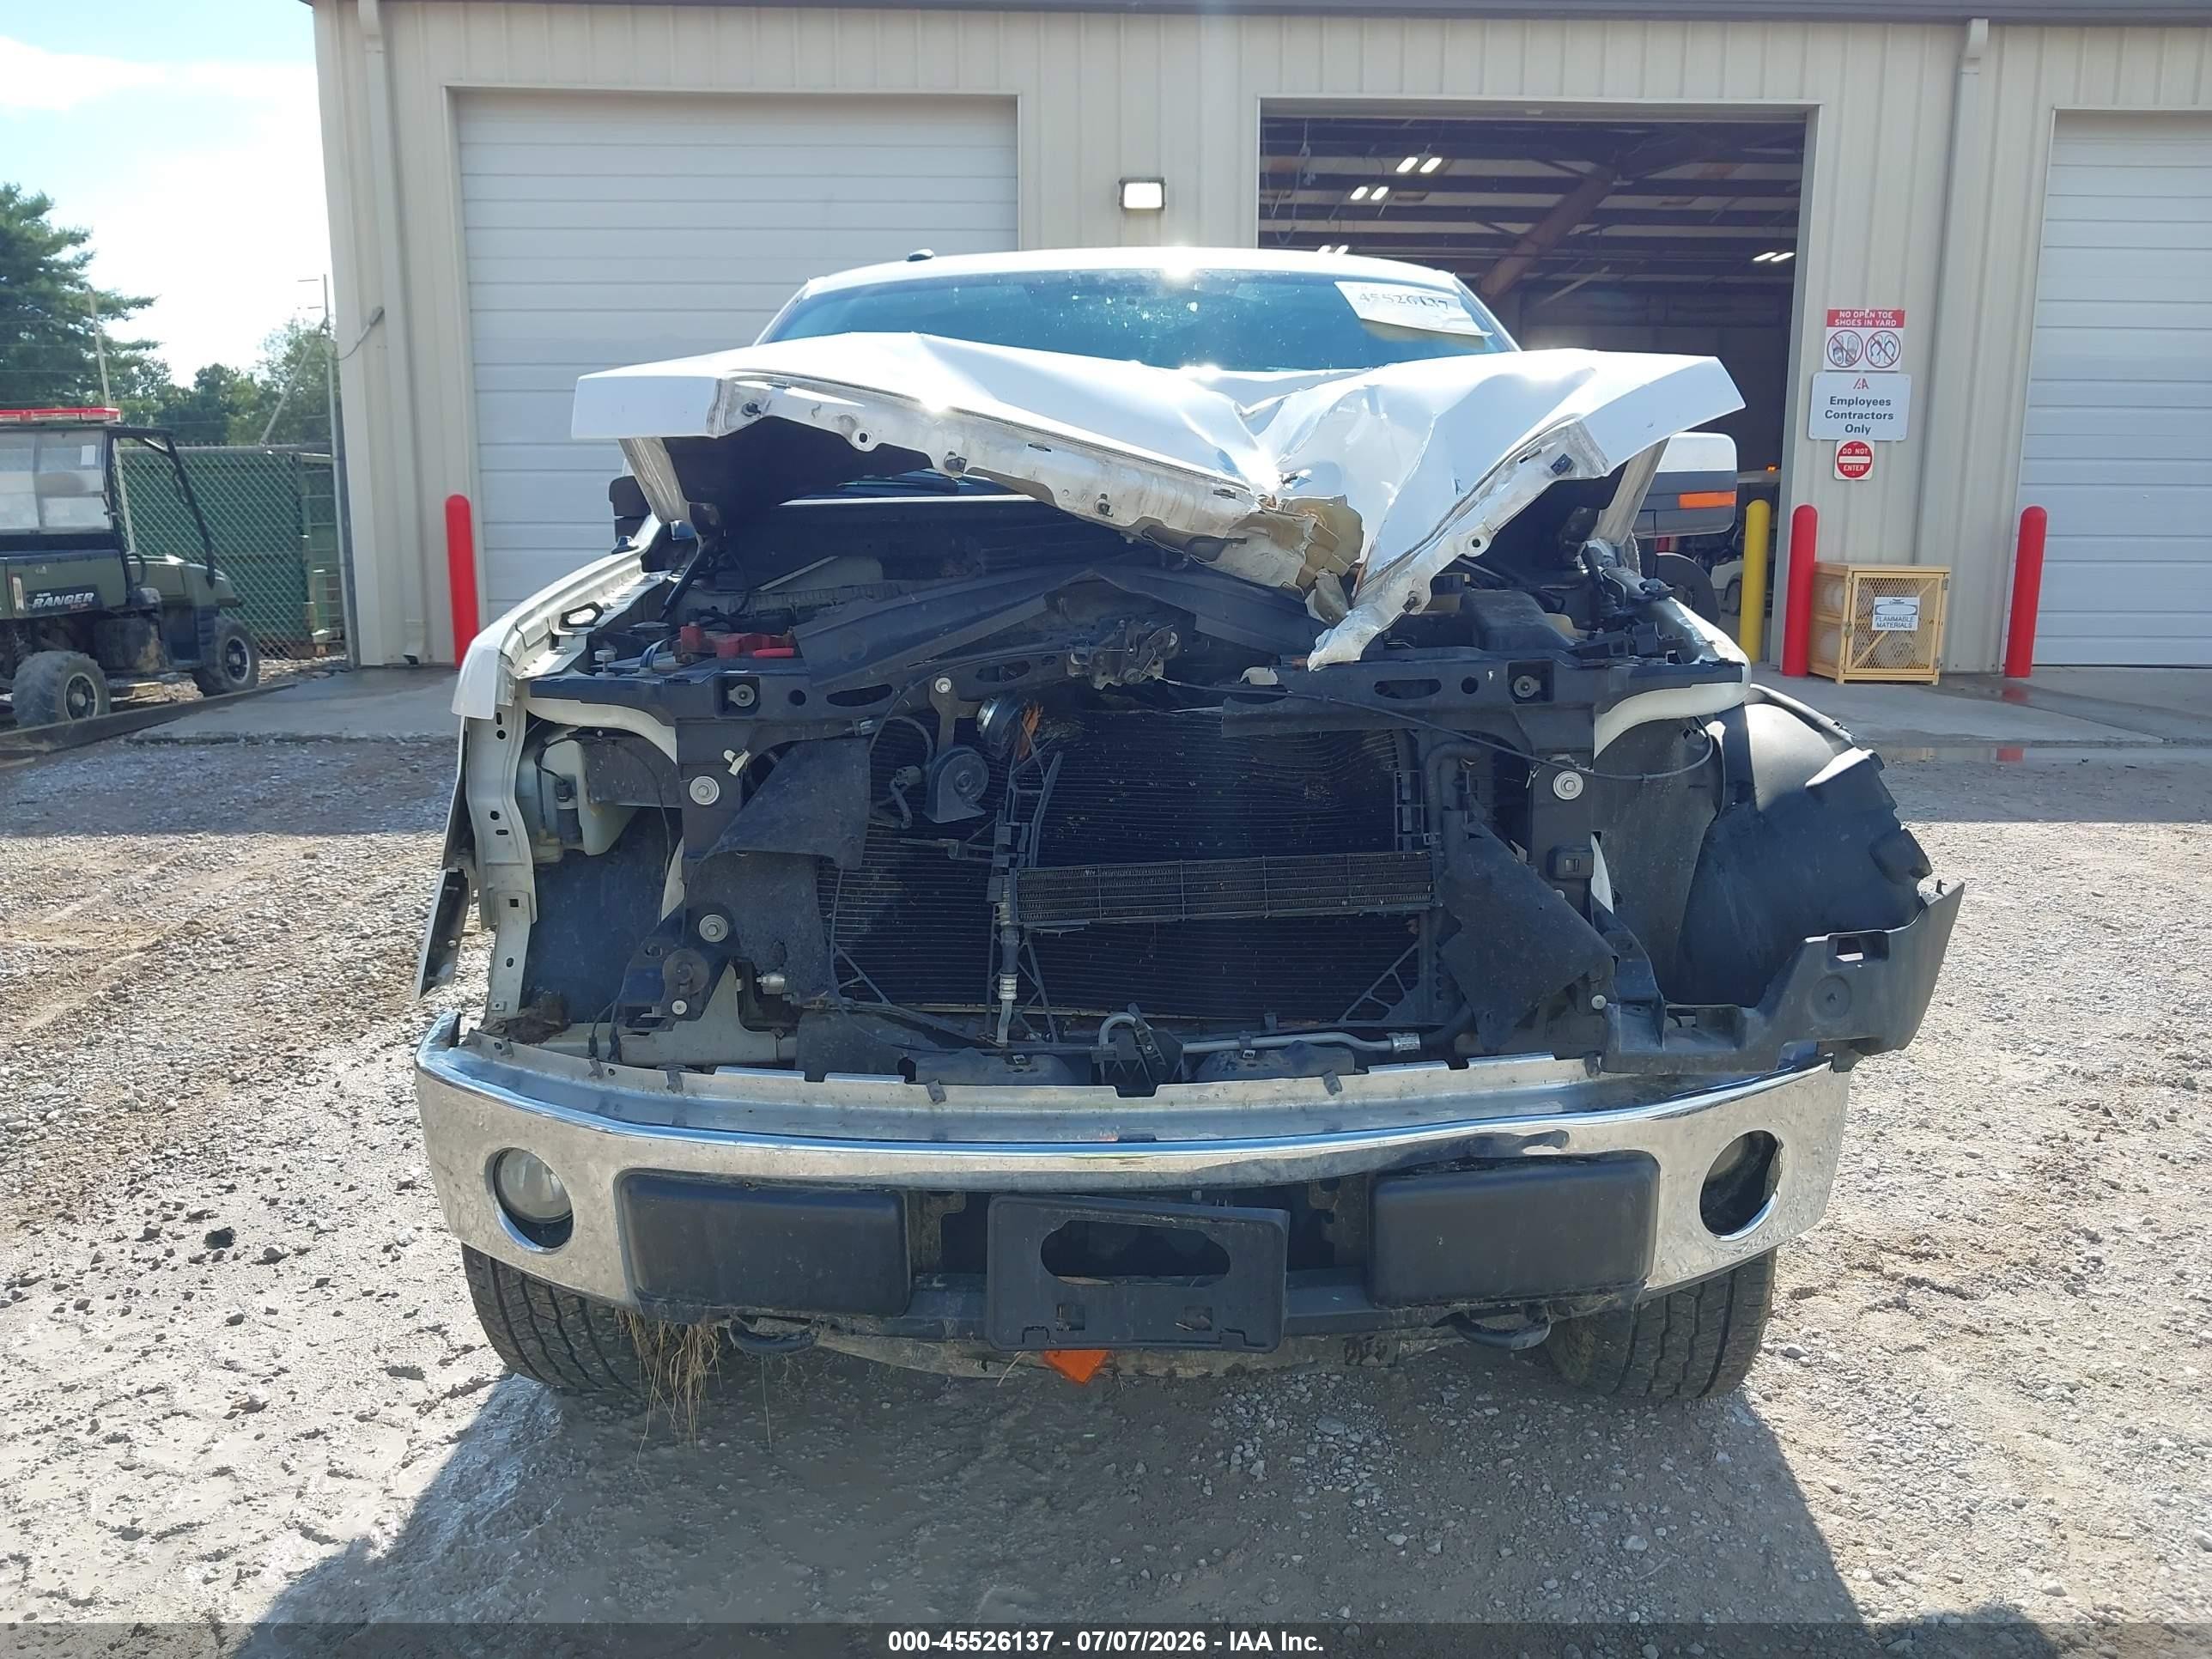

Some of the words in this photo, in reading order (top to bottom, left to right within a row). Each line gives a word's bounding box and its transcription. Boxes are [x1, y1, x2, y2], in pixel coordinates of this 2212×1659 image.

[1877, 311, 1893, 319] TOE
[1829, 396, 1892, 409] Employees
[1825, 410, 1894, 421] Contractors
[1844, 424, 1872, 435] Only
[32, 592, 94, 608] RANGER
